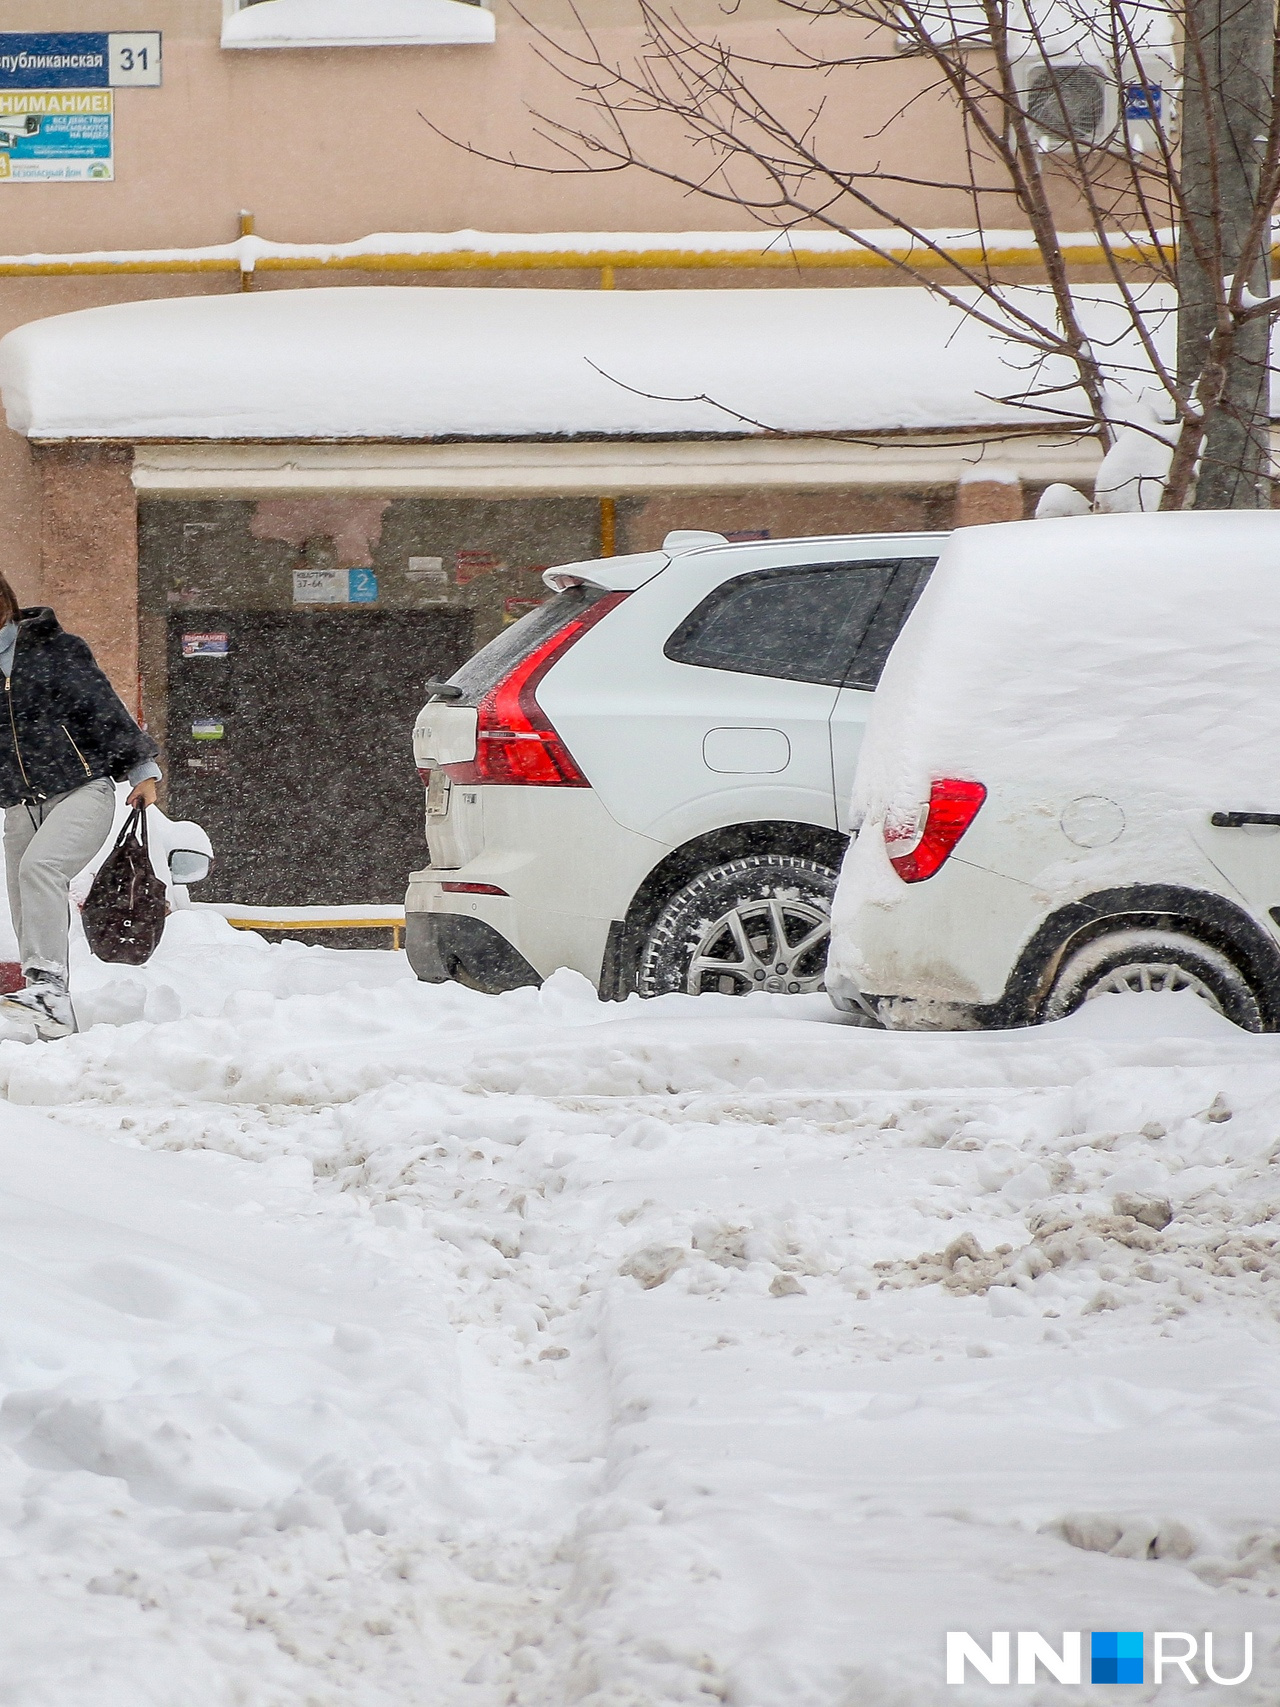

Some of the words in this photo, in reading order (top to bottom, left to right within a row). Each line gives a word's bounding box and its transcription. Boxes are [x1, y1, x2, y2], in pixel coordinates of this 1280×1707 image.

[119, 47, 148, 71] 31
[52, 116, 67, 124] ВСЕ
[356, 573, 369, 592] 2
